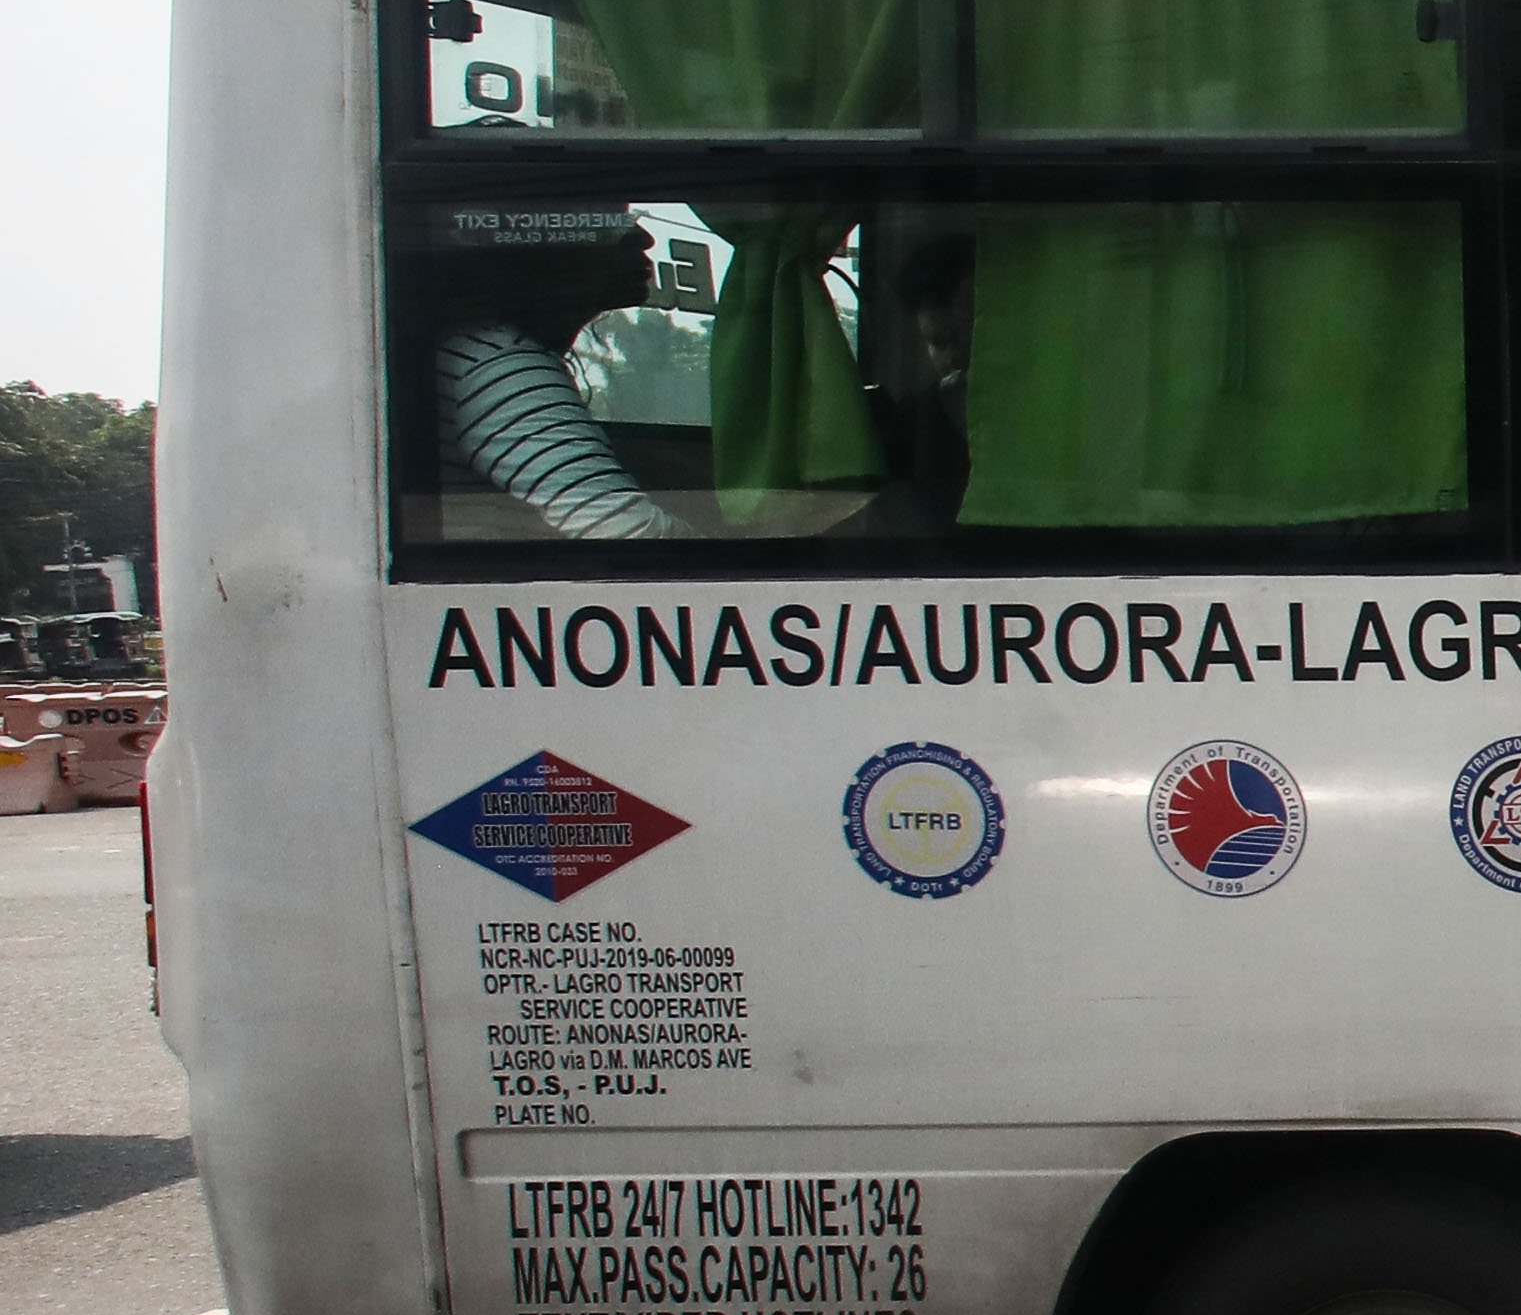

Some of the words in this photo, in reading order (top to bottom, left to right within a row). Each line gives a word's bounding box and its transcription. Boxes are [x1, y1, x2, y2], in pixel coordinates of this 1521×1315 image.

[65, 708, 139, 725] DPOS
[886, 749, 963, 769] FRANCHISING
[970, 774, 999, 847] REGULATORY
[1155, 753, 1199, 845] Department
[1207, 745, 1224, 758] of
[1235, 746, 1301, 854] Transportation
[1452, 774, 1472, 810] LAND
[483, 792, 530, 816] LAGRO
[532, 791, 616, 815] TRANSPORT
[888, 813, 963, 830] LTFRB
[474, 824, 535, 847] SERVICE
[536, 823, 632, 846] COOPERATIVE
[518, 854, 593, 863] ACCREDITATION
[1459, 834, 1516, 888] Department
[1207, 879, 1244, 893] 1899
[479, 923, 541, 944] LTFRB
[547, 923, 600, 943] CASE
[607, 922, 642, 942] NO.
[481, 947, 735, 968] NCR-NC-PUJ-2019-06-00099
[554, 973, 622, 994] LAGRO
[627, 972, 744, 993] TRANSPORT
[521, 999, 604, 1019] SERVICE
[610, 997, 748, 1019] COOPERATIVE
[488, 1024, 561, 1045] ROUTE:
[567, 1023, 747, 1045] ANONAS/AURORA-
[489, 1050, 555, 1071] LAGRO
[560, 1050, 585, 1070] via
[590, 1049, 628, 1070] D.M.
[633, 1049, 712, 1069] MARCOS
[717, 1048, 752, 1069] AVE
[595, 1074, 666, 1095] P.U.J.
[495, 1104, 555, 1125] PLATE
[562, 1104, 596, 1125] NO.
[509, 1181, 614, 1240] LTFRB
[623, 1179, 687, 1238] 24/7
[888, 1244, 927, 1303] 26
